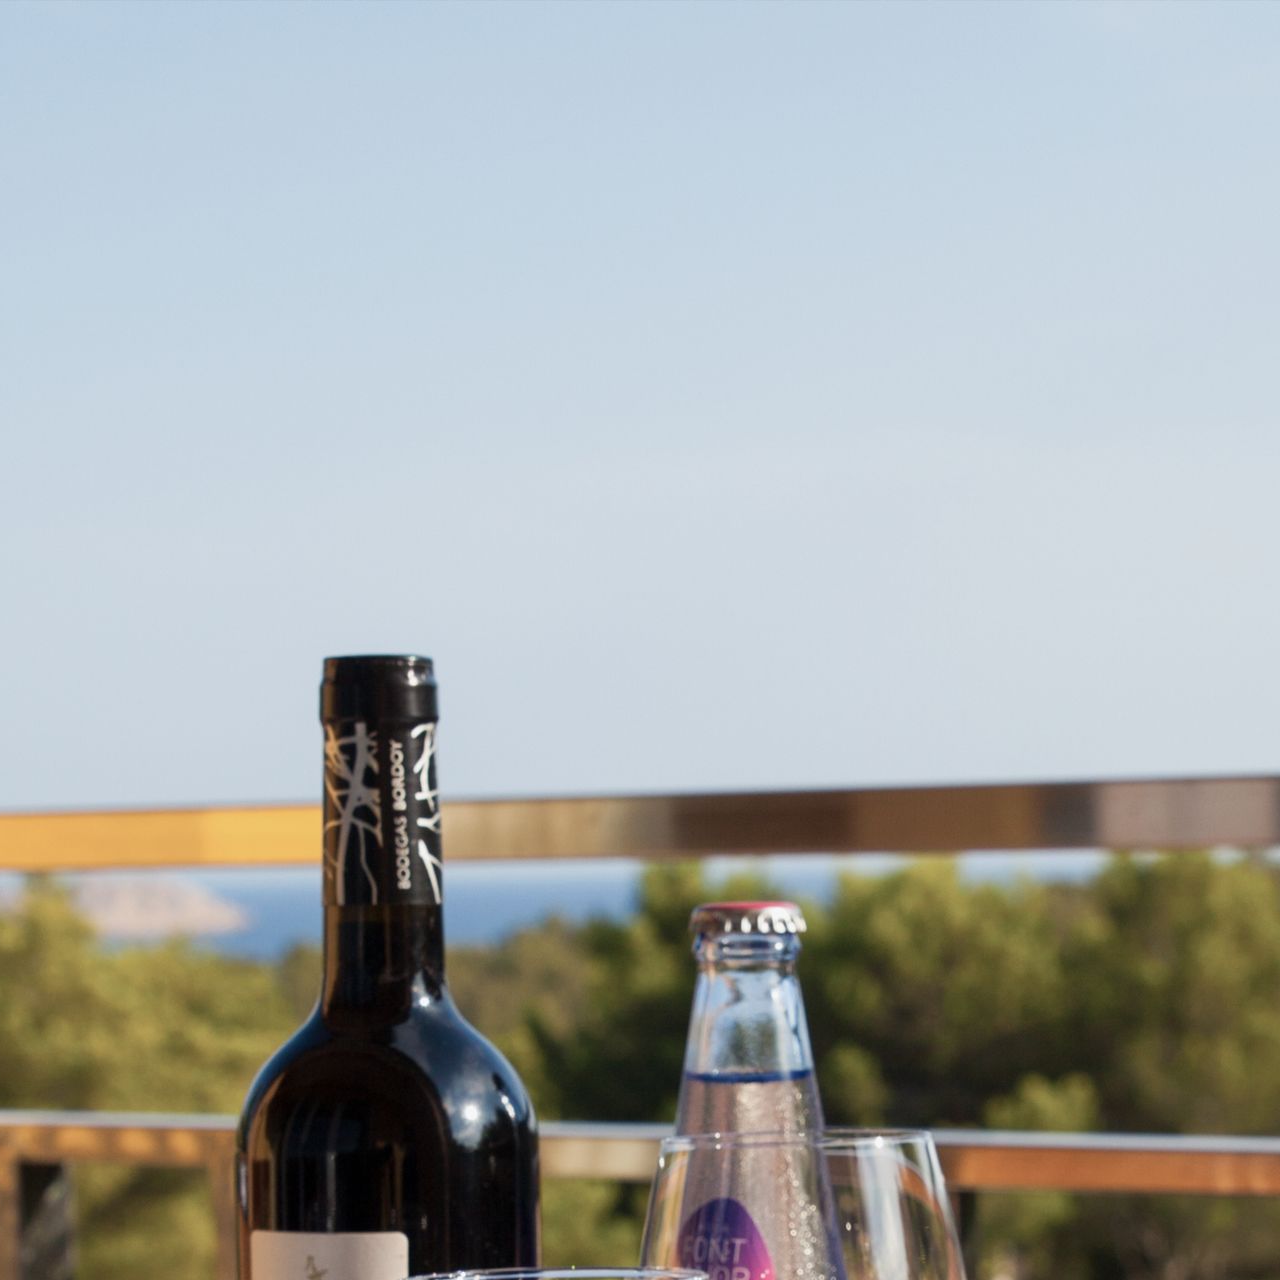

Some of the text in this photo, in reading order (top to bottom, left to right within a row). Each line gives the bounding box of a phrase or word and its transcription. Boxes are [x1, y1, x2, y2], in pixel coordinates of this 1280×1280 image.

[390, 739, 411, 890] BODEGAS BORDOY
[684, 1235, 749, 1263] FONT
